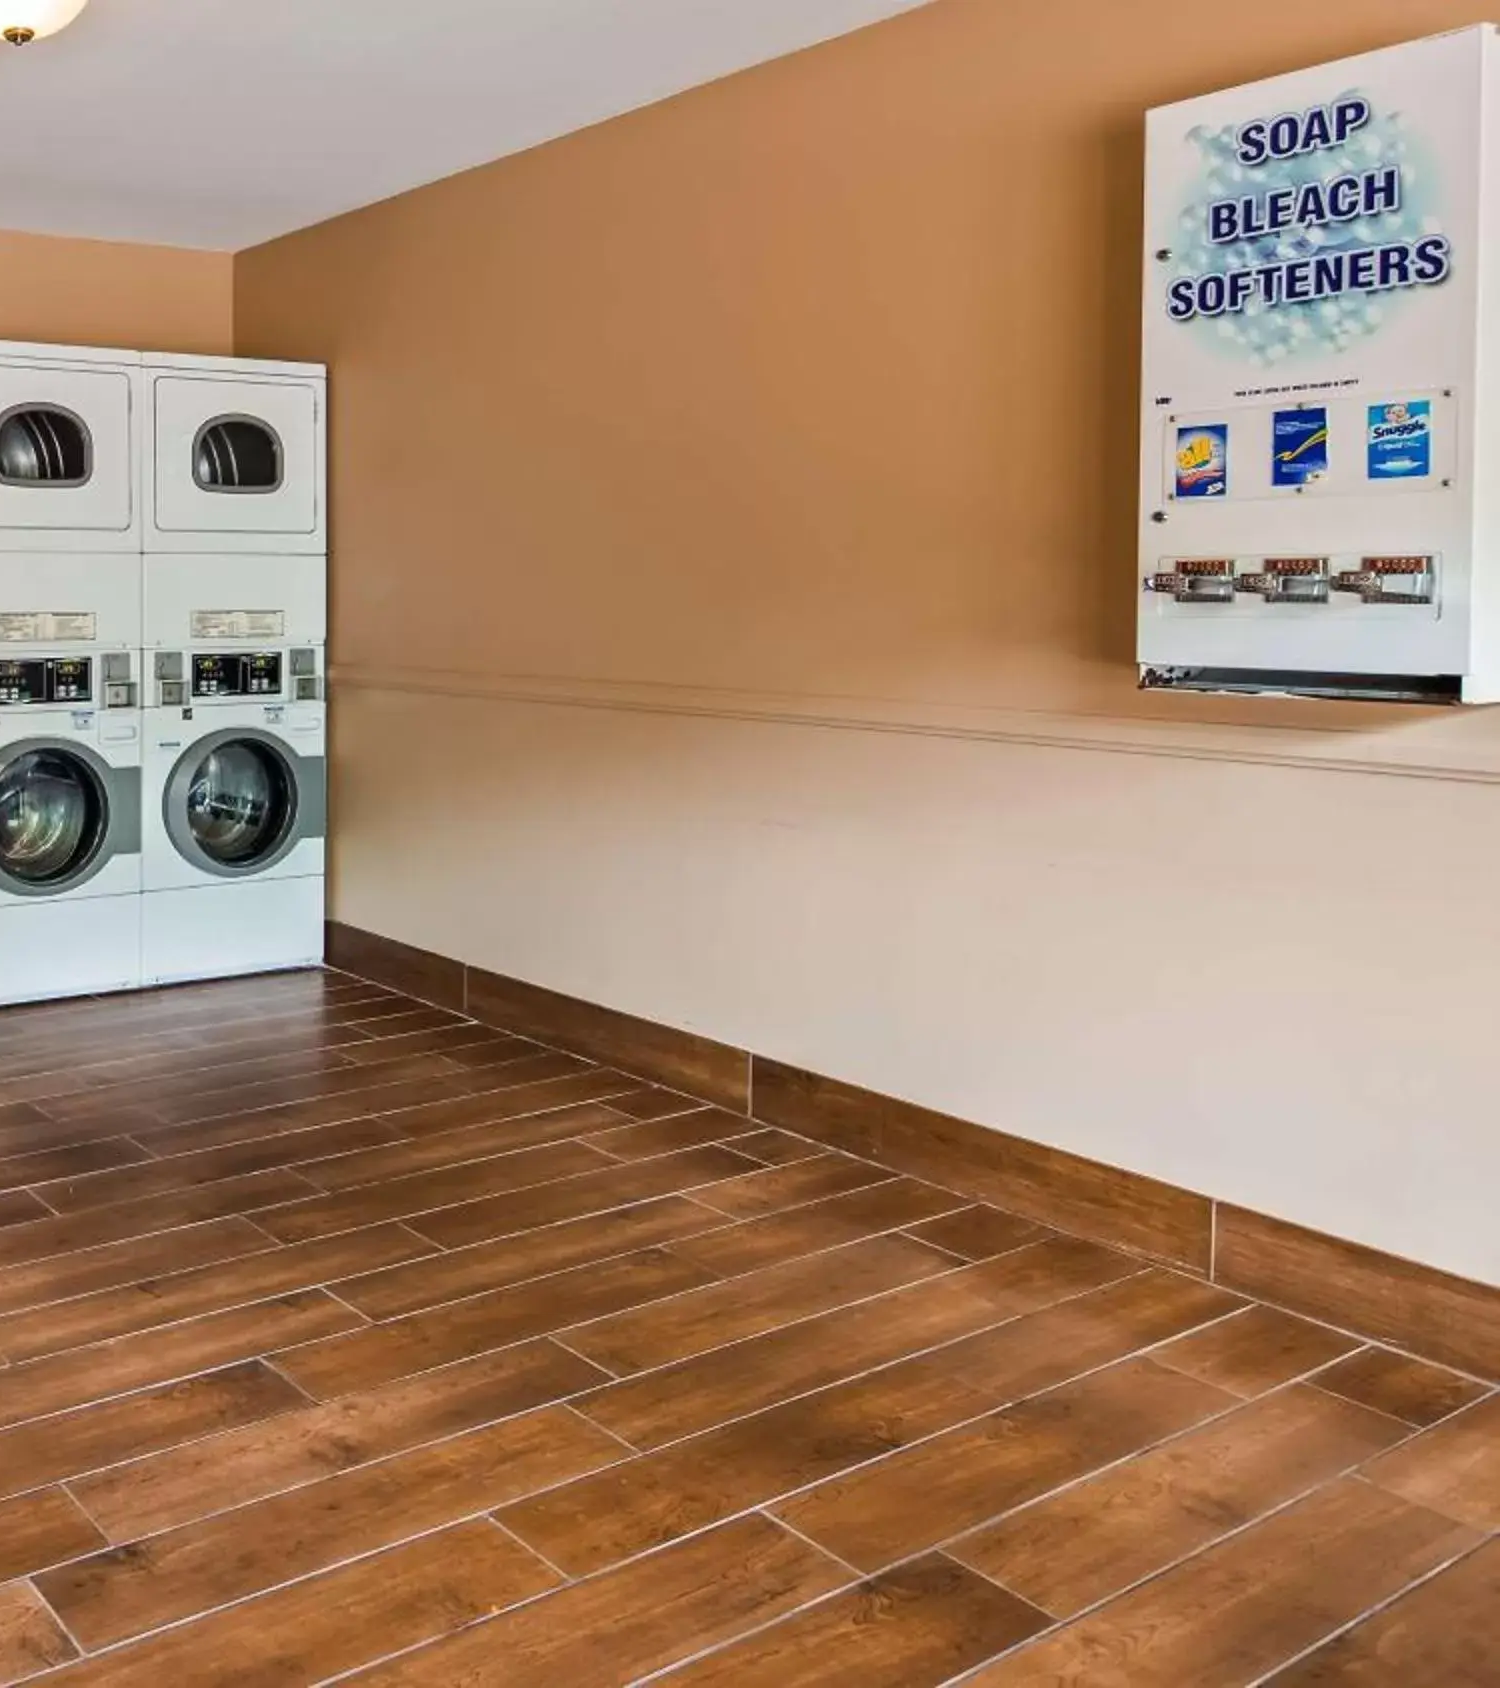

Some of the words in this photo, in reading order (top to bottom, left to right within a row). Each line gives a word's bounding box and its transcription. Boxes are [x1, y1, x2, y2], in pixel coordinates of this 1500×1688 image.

[1239, 99, 1368, 164] SOAP
[1210, 168, 1399, 242] BLEACH
[1169, 238, 1449, 319] SOFTENERS
[1373, 419, 1427, 439] Snuggle
